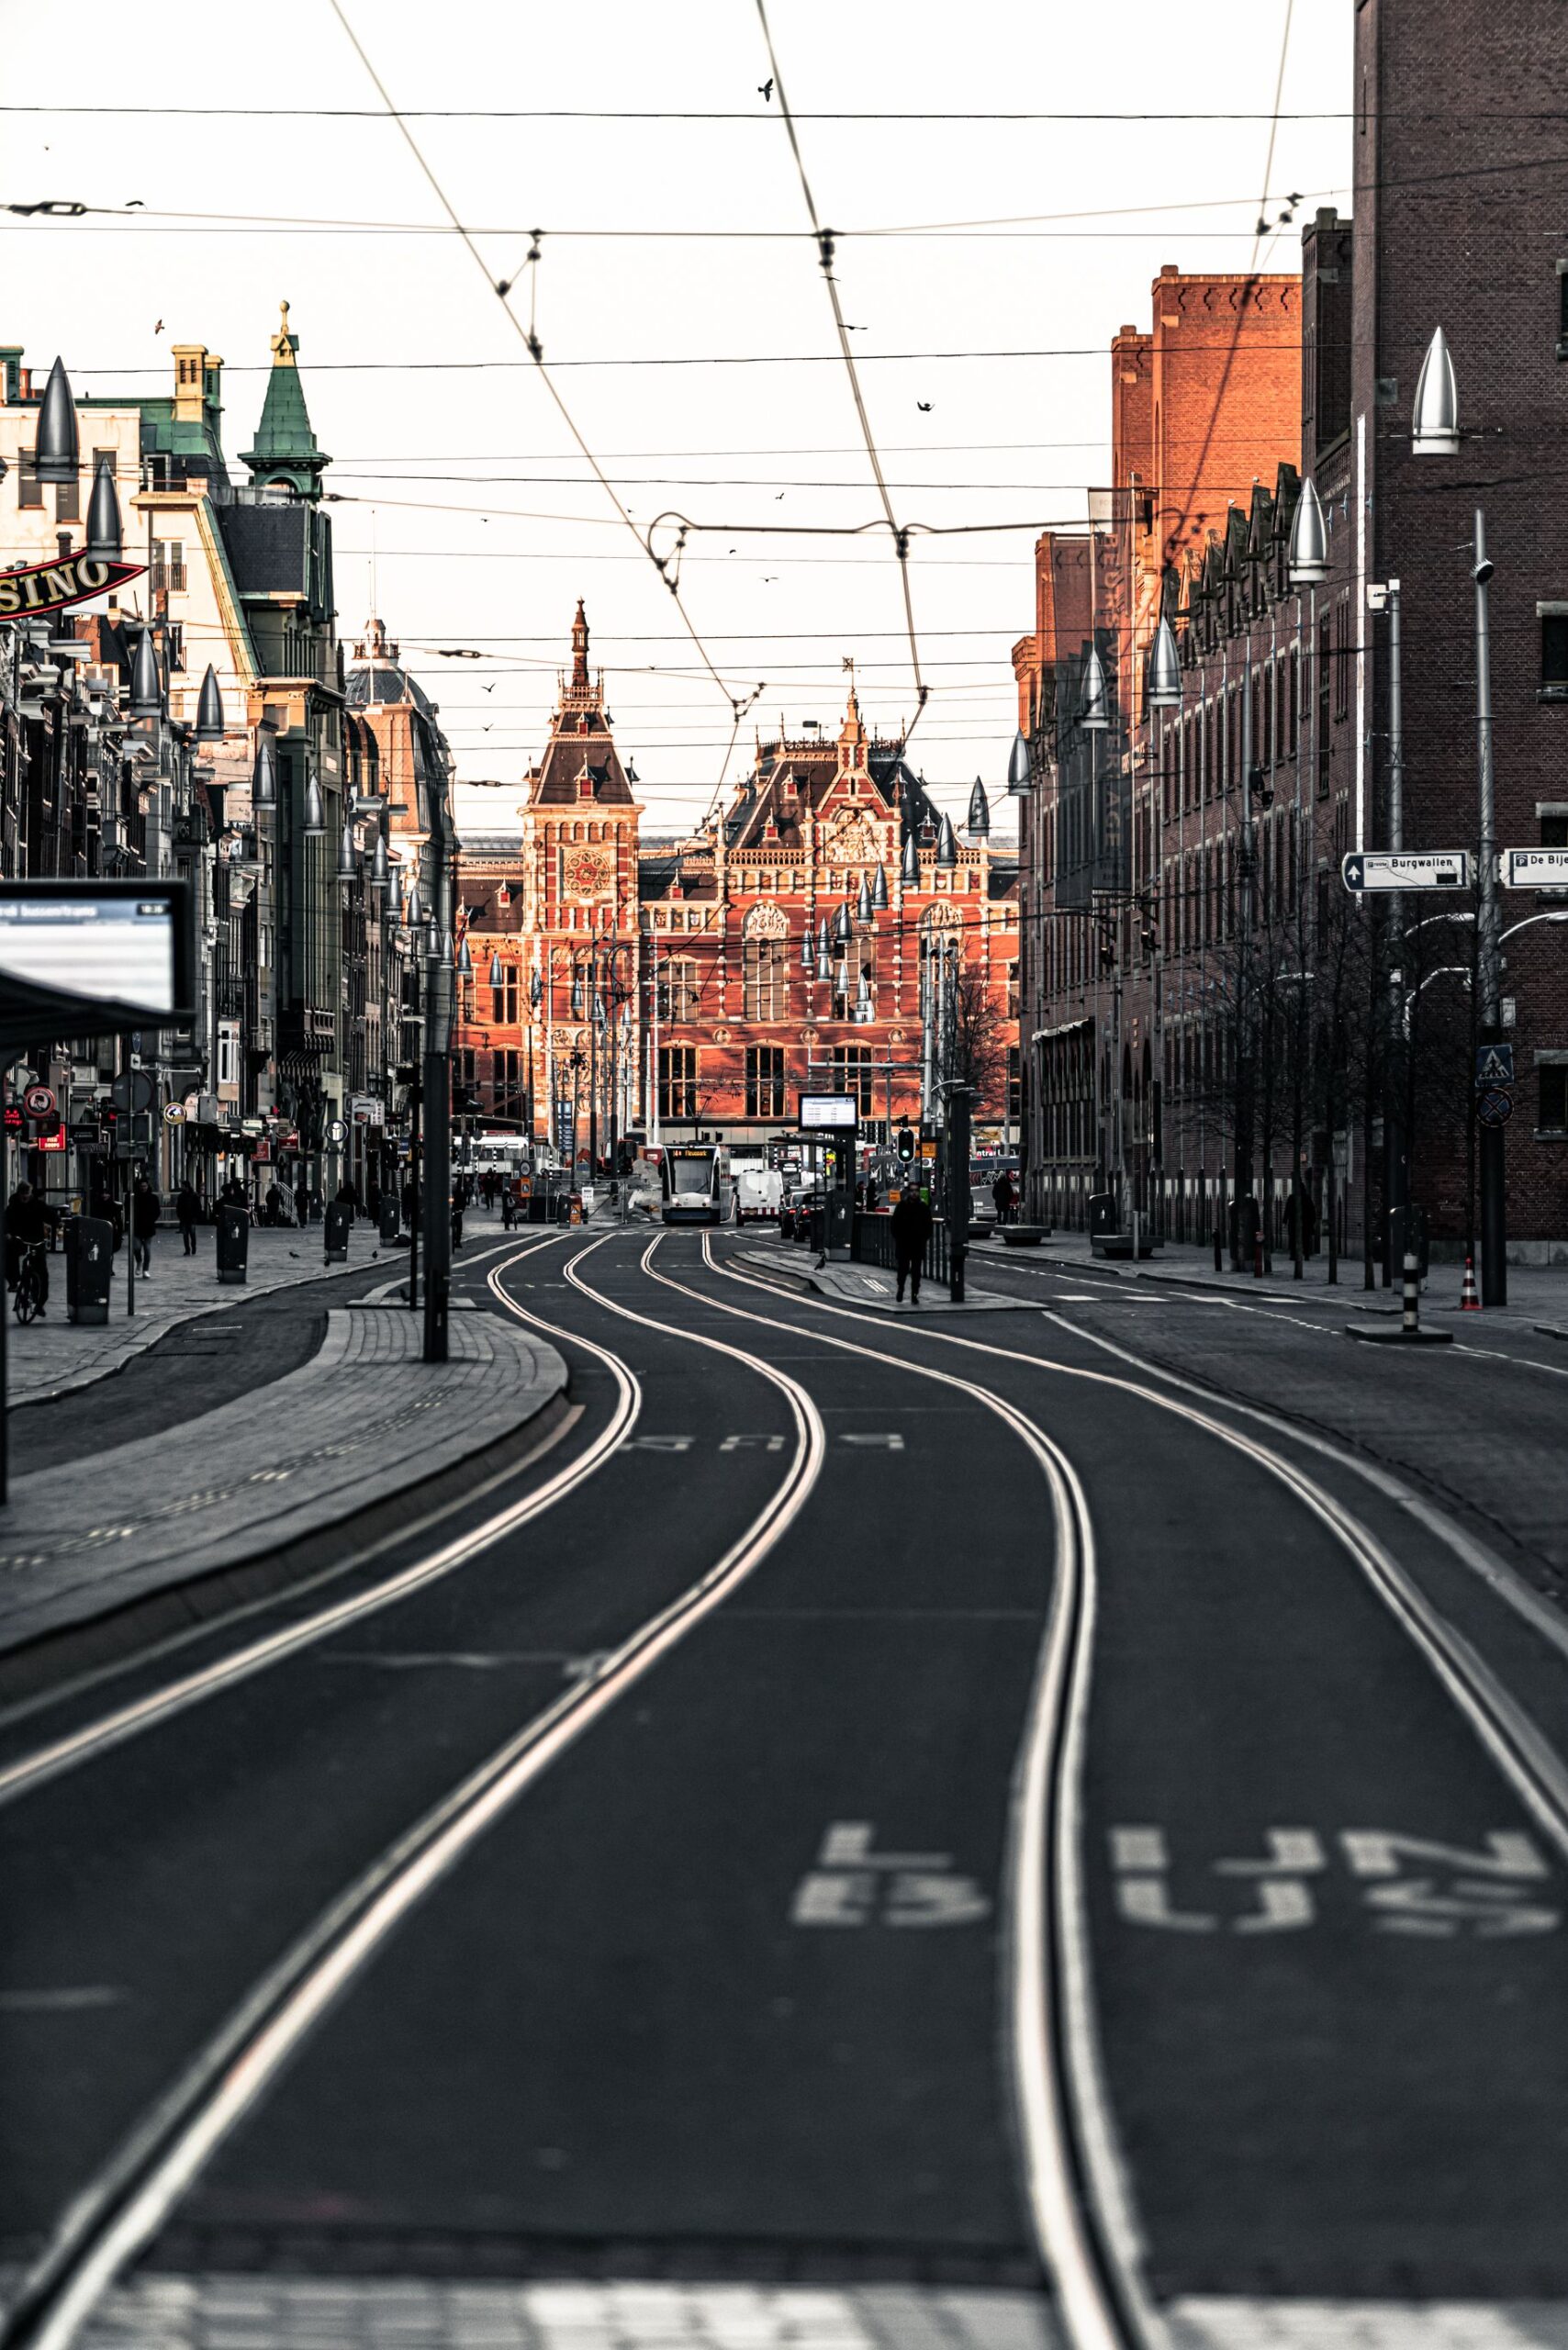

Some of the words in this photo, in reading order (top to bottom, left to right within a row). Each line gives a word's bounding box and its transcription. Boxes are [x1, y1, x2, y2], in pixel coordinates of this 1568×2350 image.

[0, 556, 109, 611] SINO
[1392, 857, 1453, 869] Burgwallen
[1531, 856, 1544, 864] De
